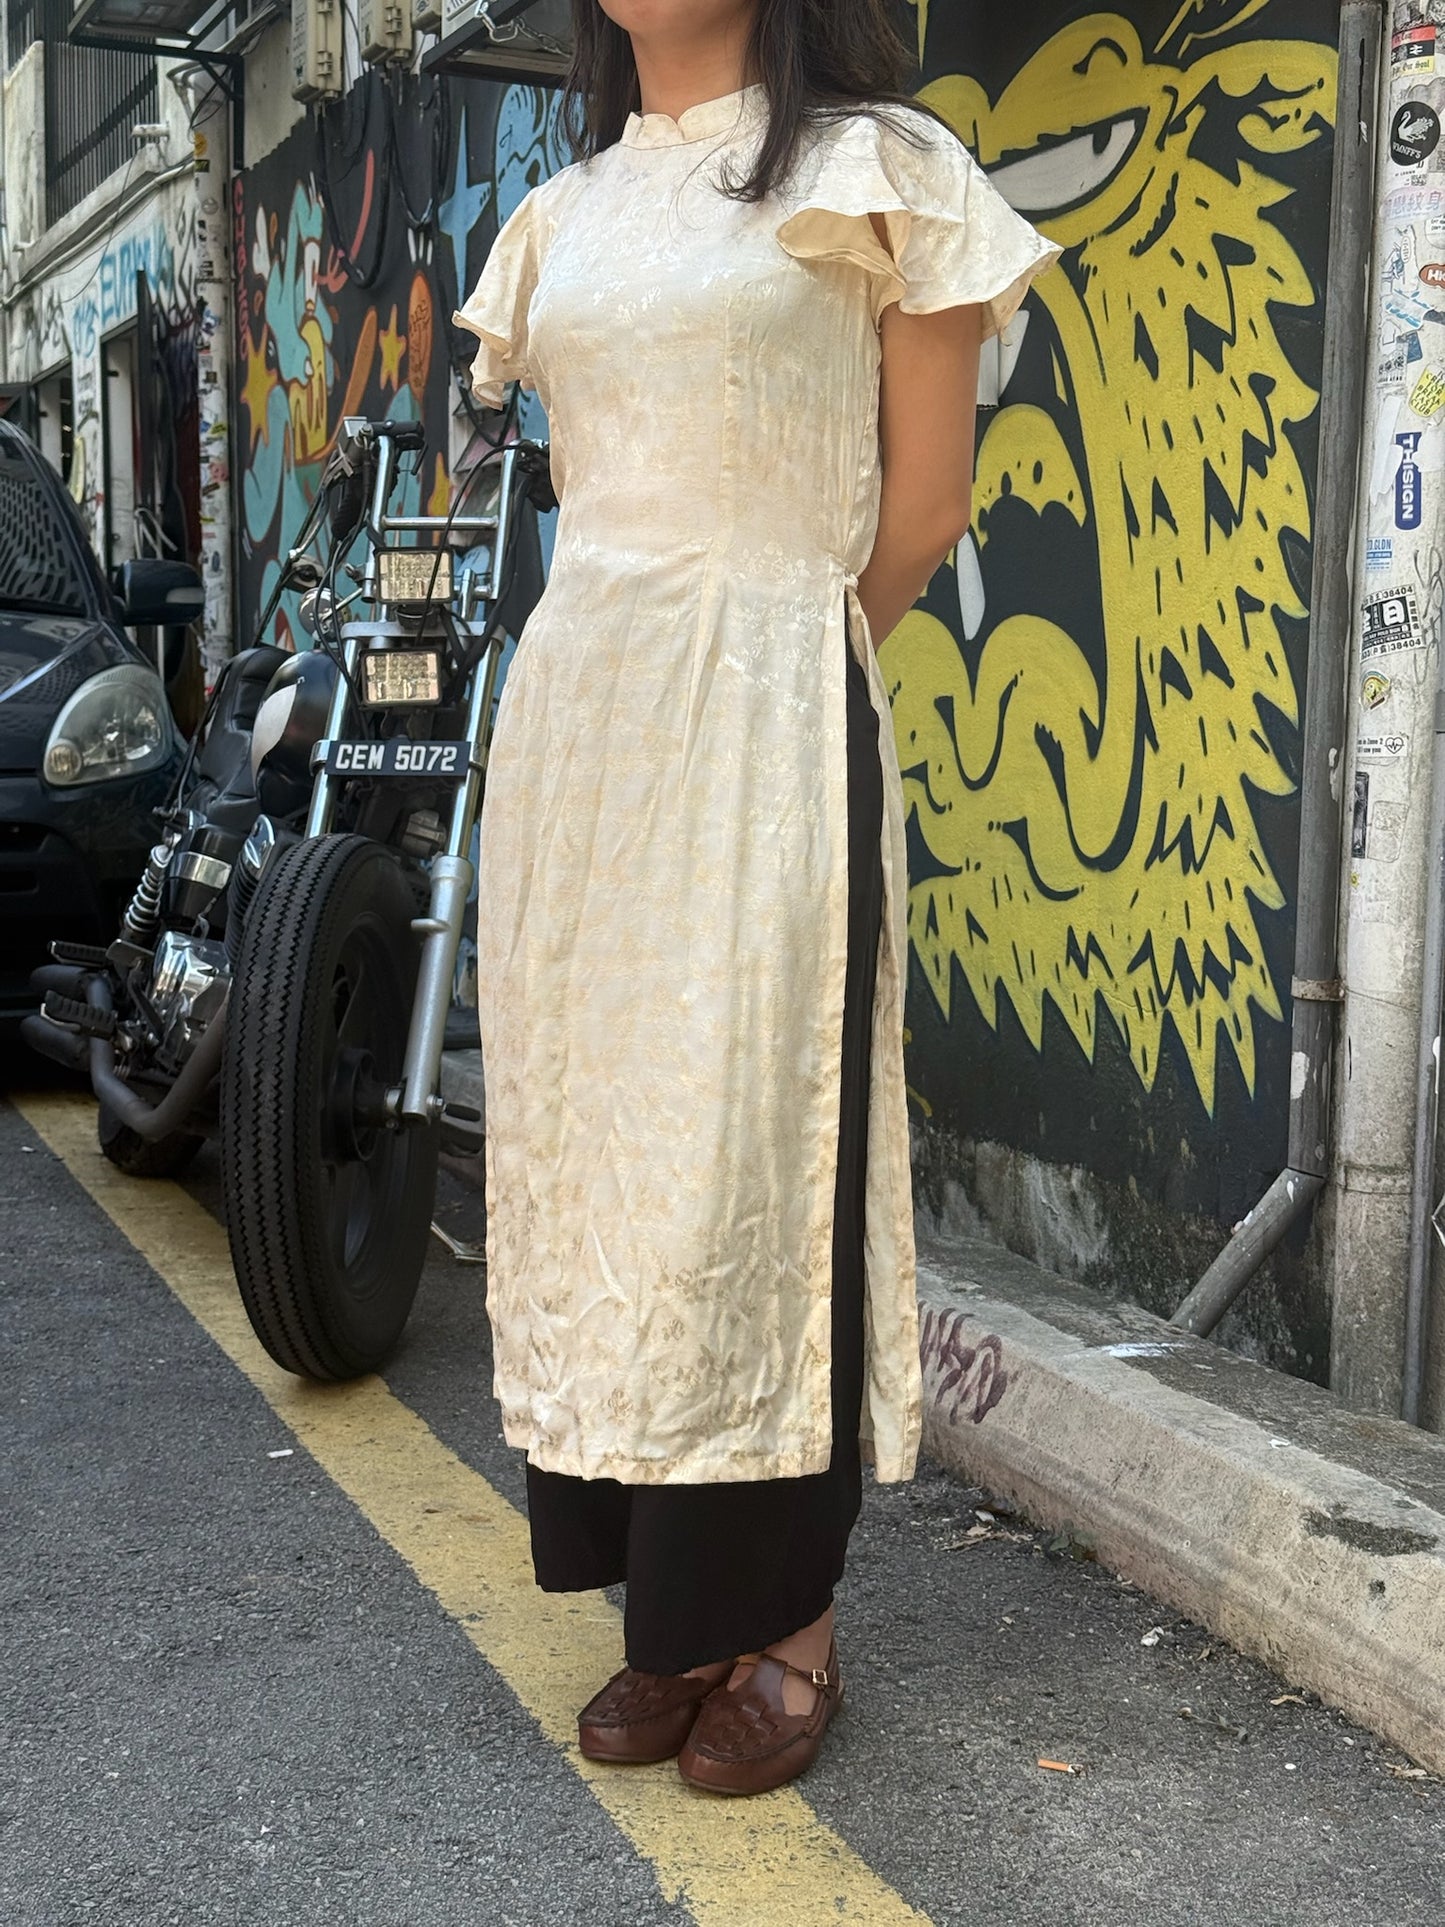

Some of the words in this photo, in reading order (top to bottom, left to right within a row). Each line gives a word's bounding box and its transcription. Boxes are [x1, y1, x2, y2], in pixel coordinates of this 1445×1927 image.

[1410, 399, 1431, 415] CLUB
[1402, 434, 1414, 520] THISIGN
[335, 744, 384, 770] CEM
[394, 745, 457, 772] 5072
